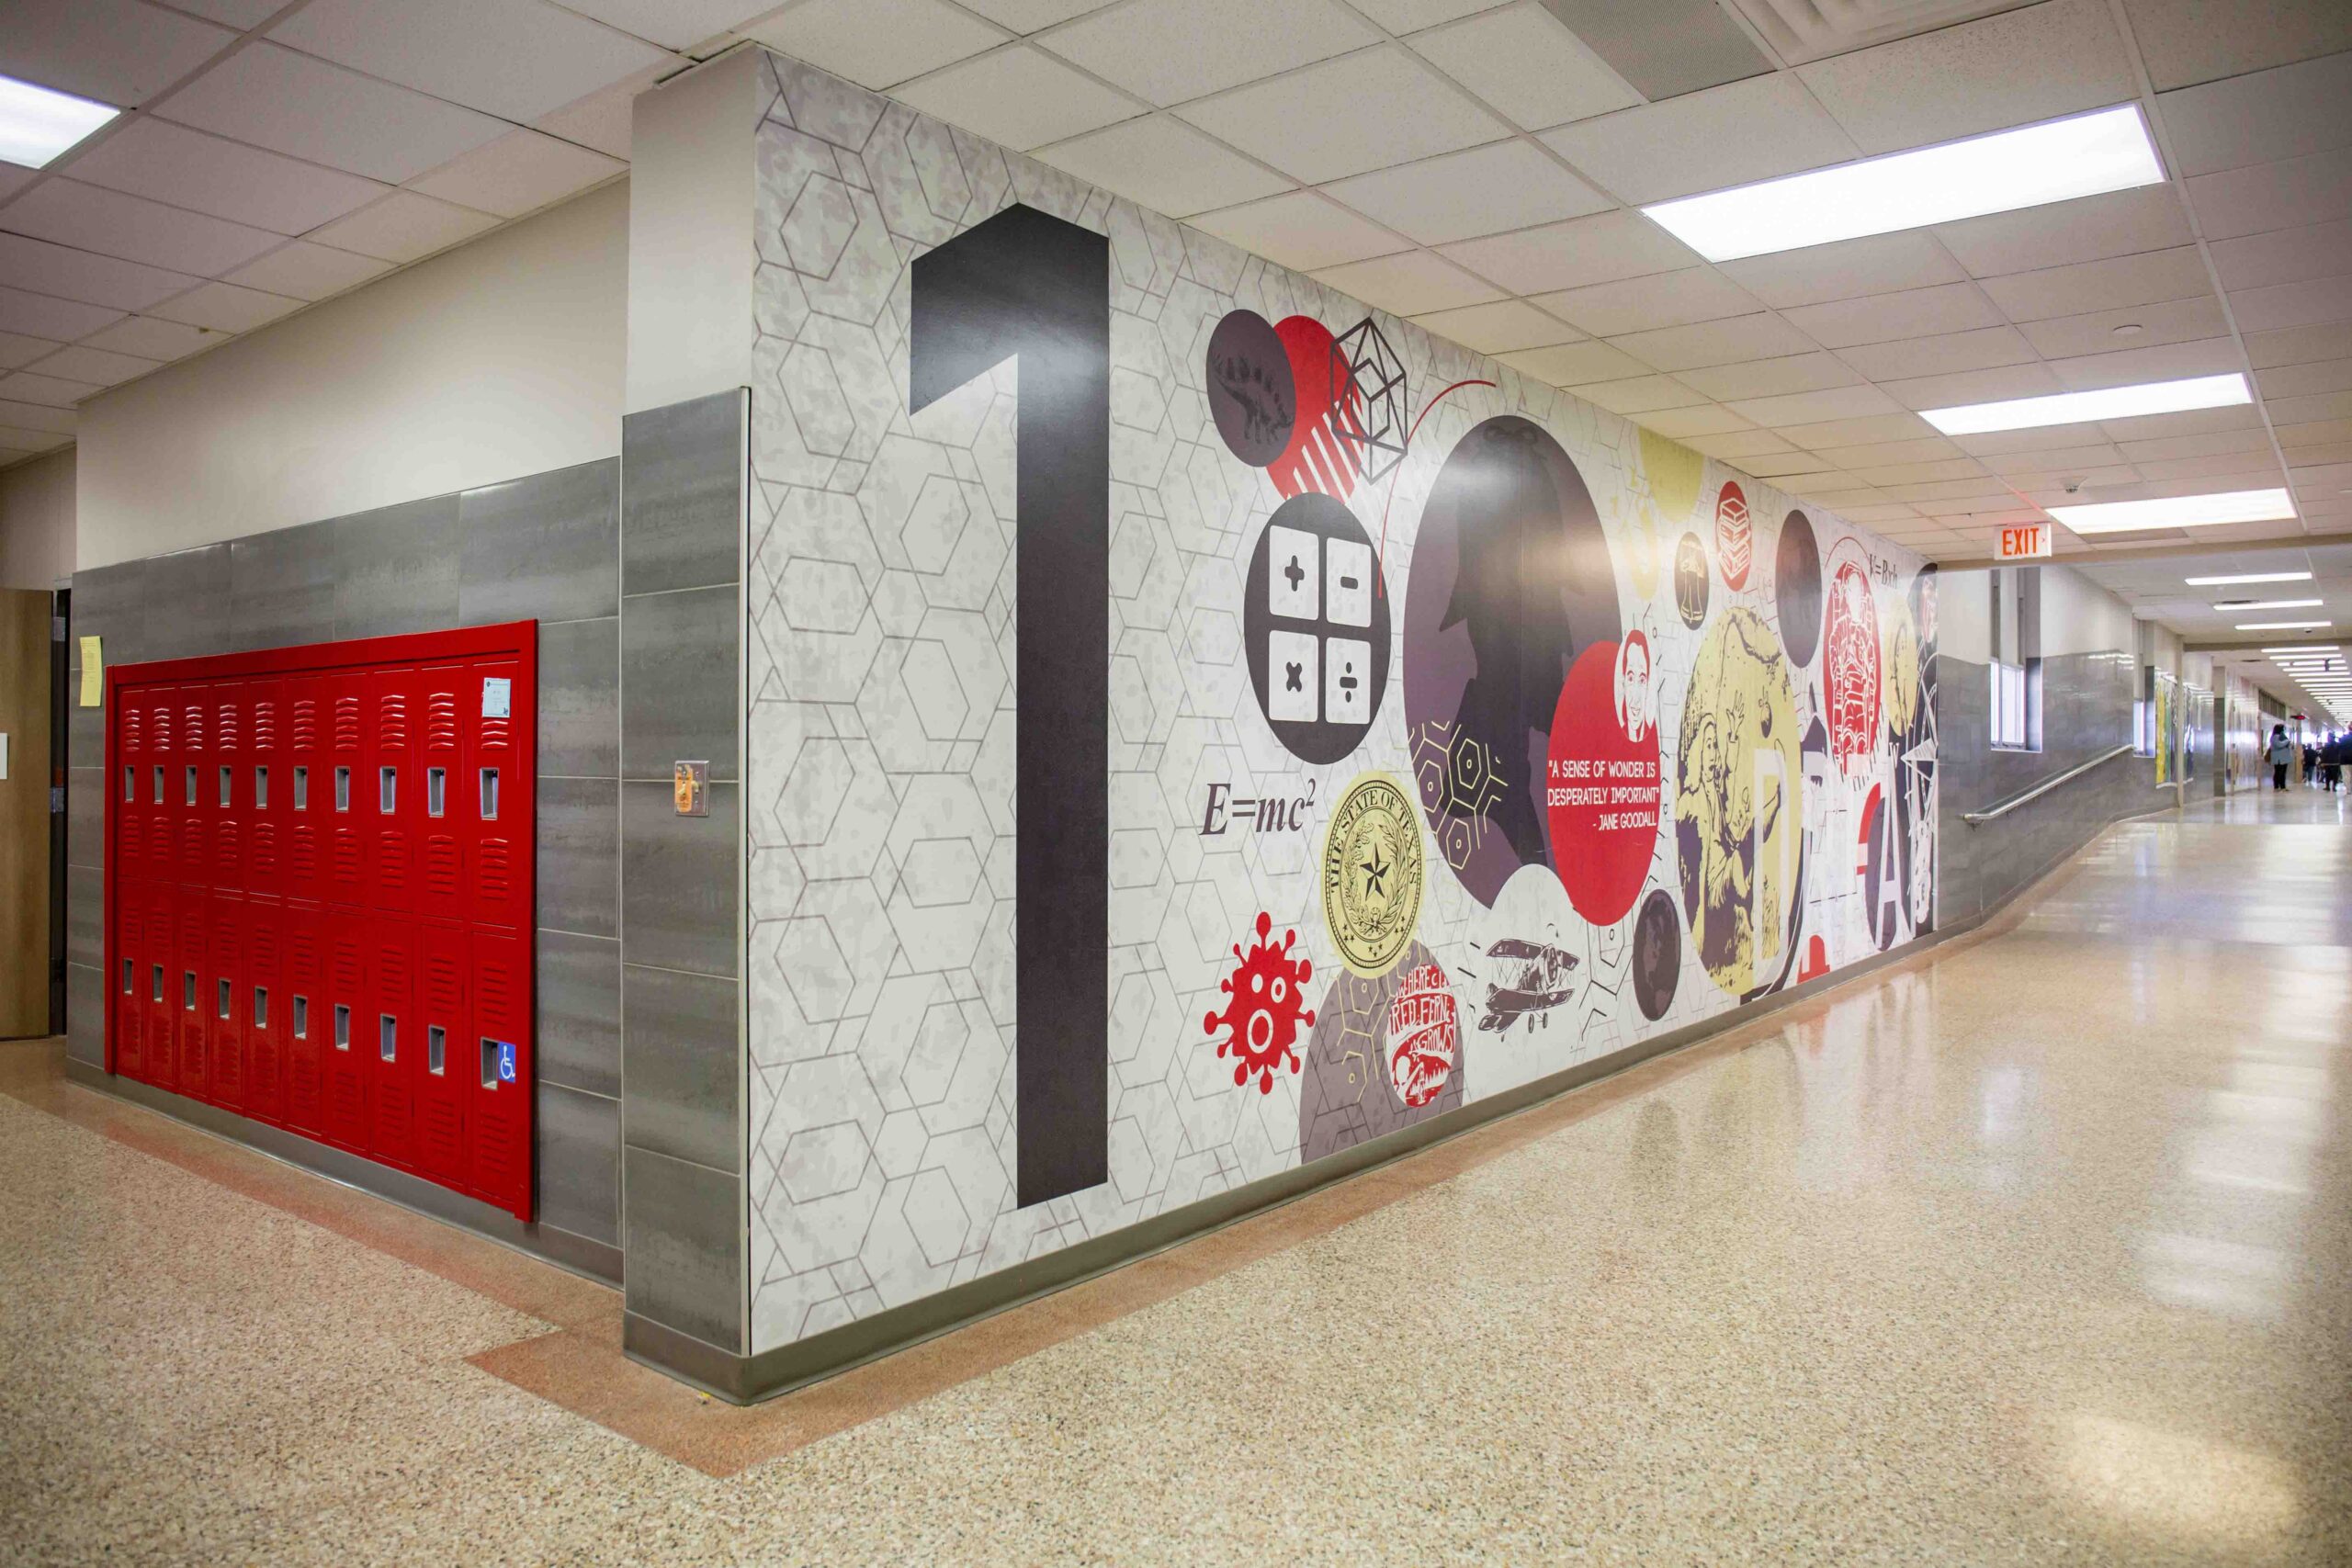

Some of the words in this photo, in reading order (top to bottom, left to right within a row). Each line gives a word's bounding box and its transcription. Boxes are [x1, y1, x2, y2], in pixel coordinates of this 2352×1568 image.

[2002, 527, 2040, 556] EXIT
[1562, 761, 1590, 778] SENSE
[1593, 761, 1606, 778] OF
[1608, 761, 1645, 778] WONDER
[1645, 761, 1657, 778] IS
[1547, 786, 1609, 807] DESPERATELY
[1599, 813, 1618, 831] JANE
[1620, 811, 1657, 829] GOODALL
[1330, 836, 1344, 893] THE
[1341, 789, 1378, 834] STATE
[1381, 791, 1398, 810] OF
[1397, 807, 1418, 885] TEXAS
[1395, 964, 1431, 1004] WHERE
[1391, 998, 1417, 1035] RED
[1419, 995, 1448, 1026] FERN
[1417, 1024, 1453, 1054] GROWS
